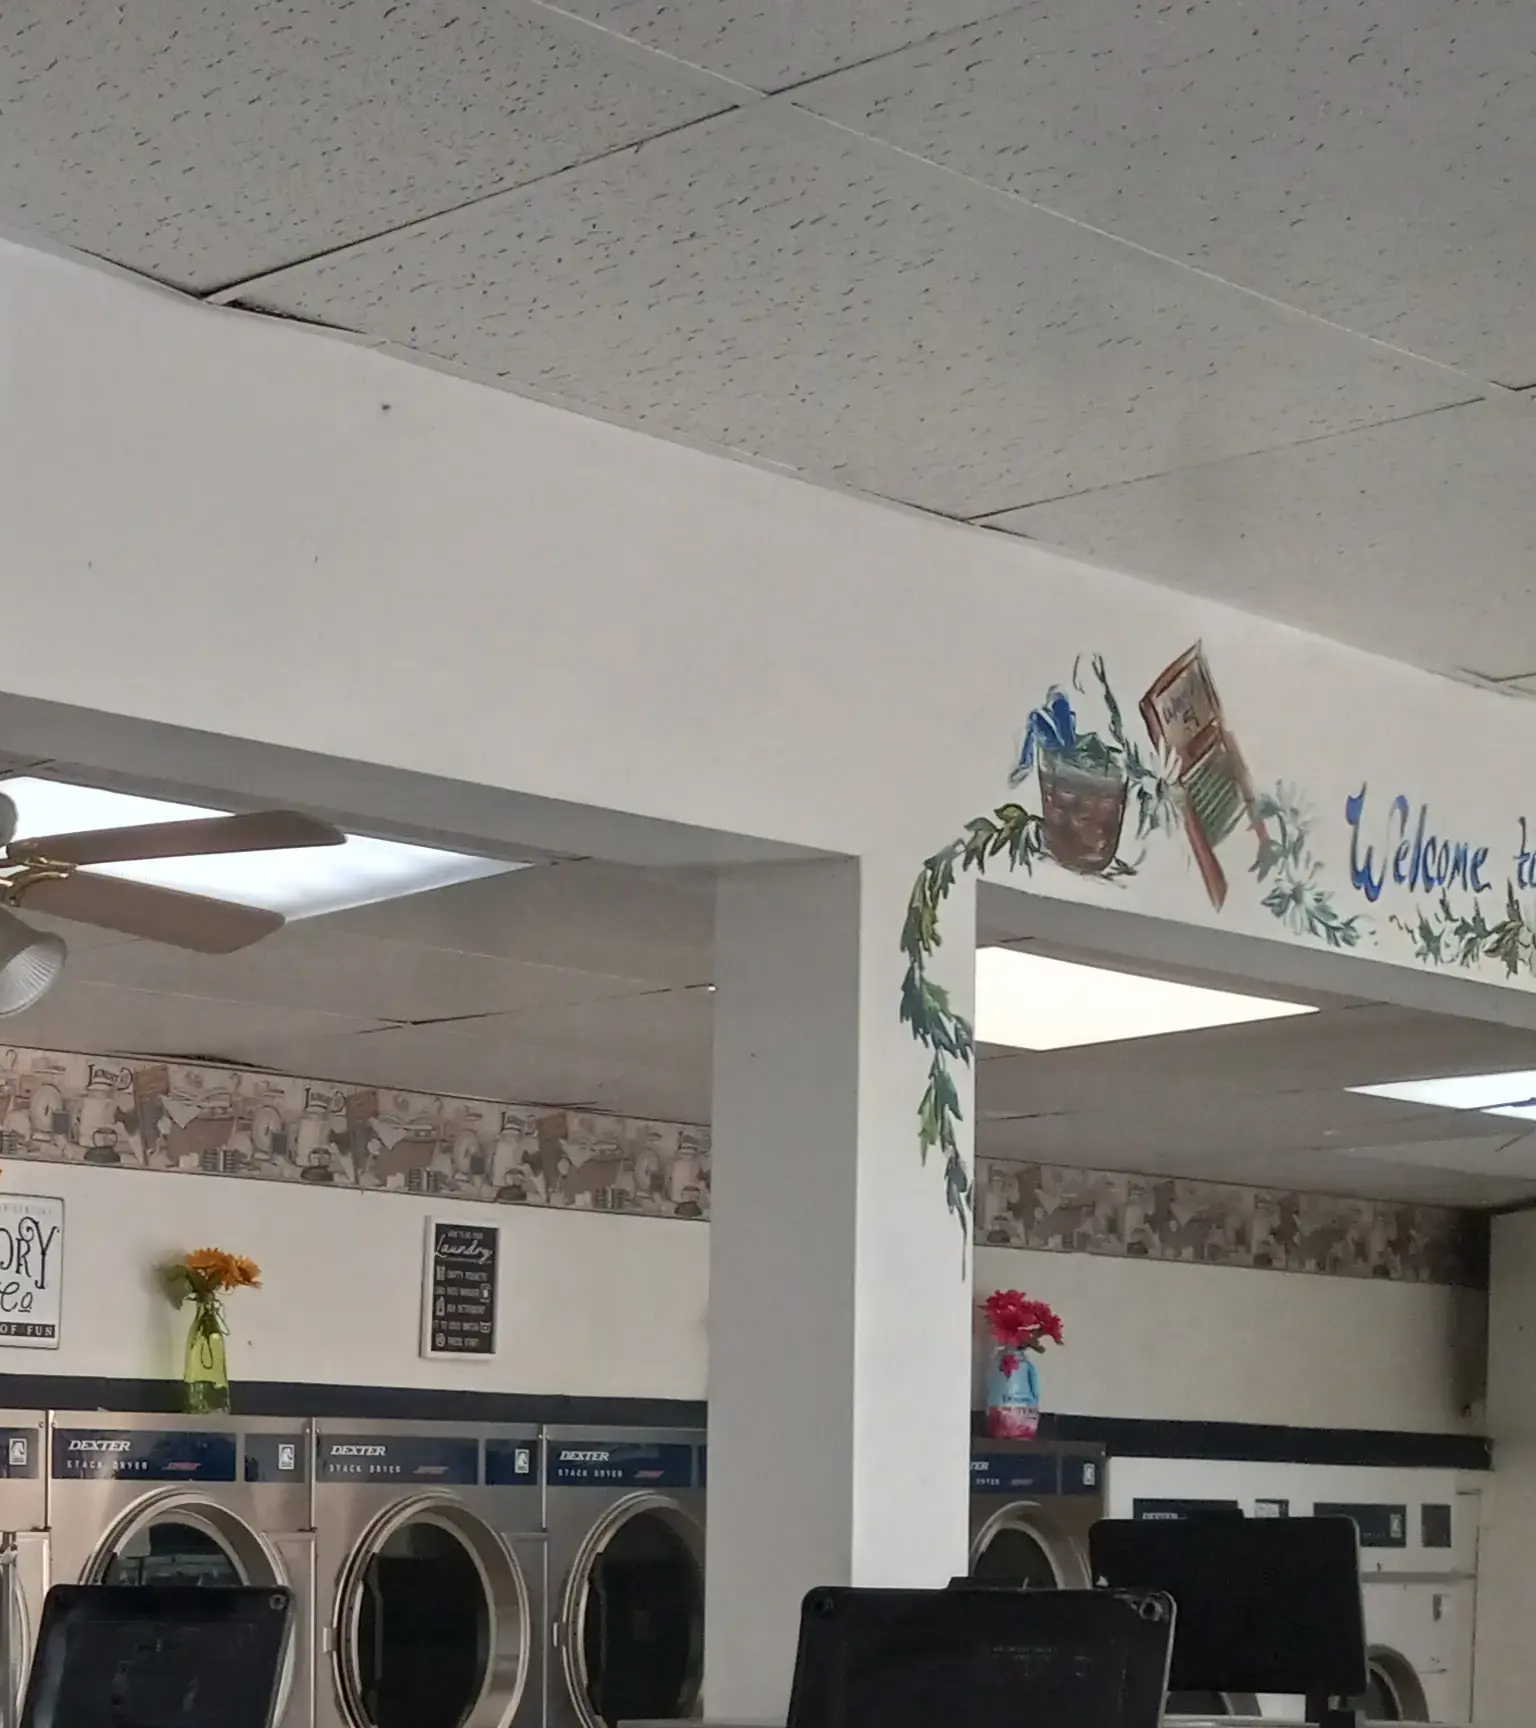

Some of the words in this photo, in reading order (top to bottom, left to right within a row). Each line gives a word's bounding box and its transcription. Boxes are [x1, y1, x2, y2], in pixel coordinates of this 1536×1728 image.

[1345, 782, 1492, 902] Welcome
[436, 1234, 492, 1265] Laundry
[0, 1323, 17, 1335] OF
[27, 1325, 53, 1337] FUN
[68, 1440, 131, 1451] DEXTER
[330, 1445, 386, 1456] DEXTER
[559, 1450, 610, 1461] DEXTER
